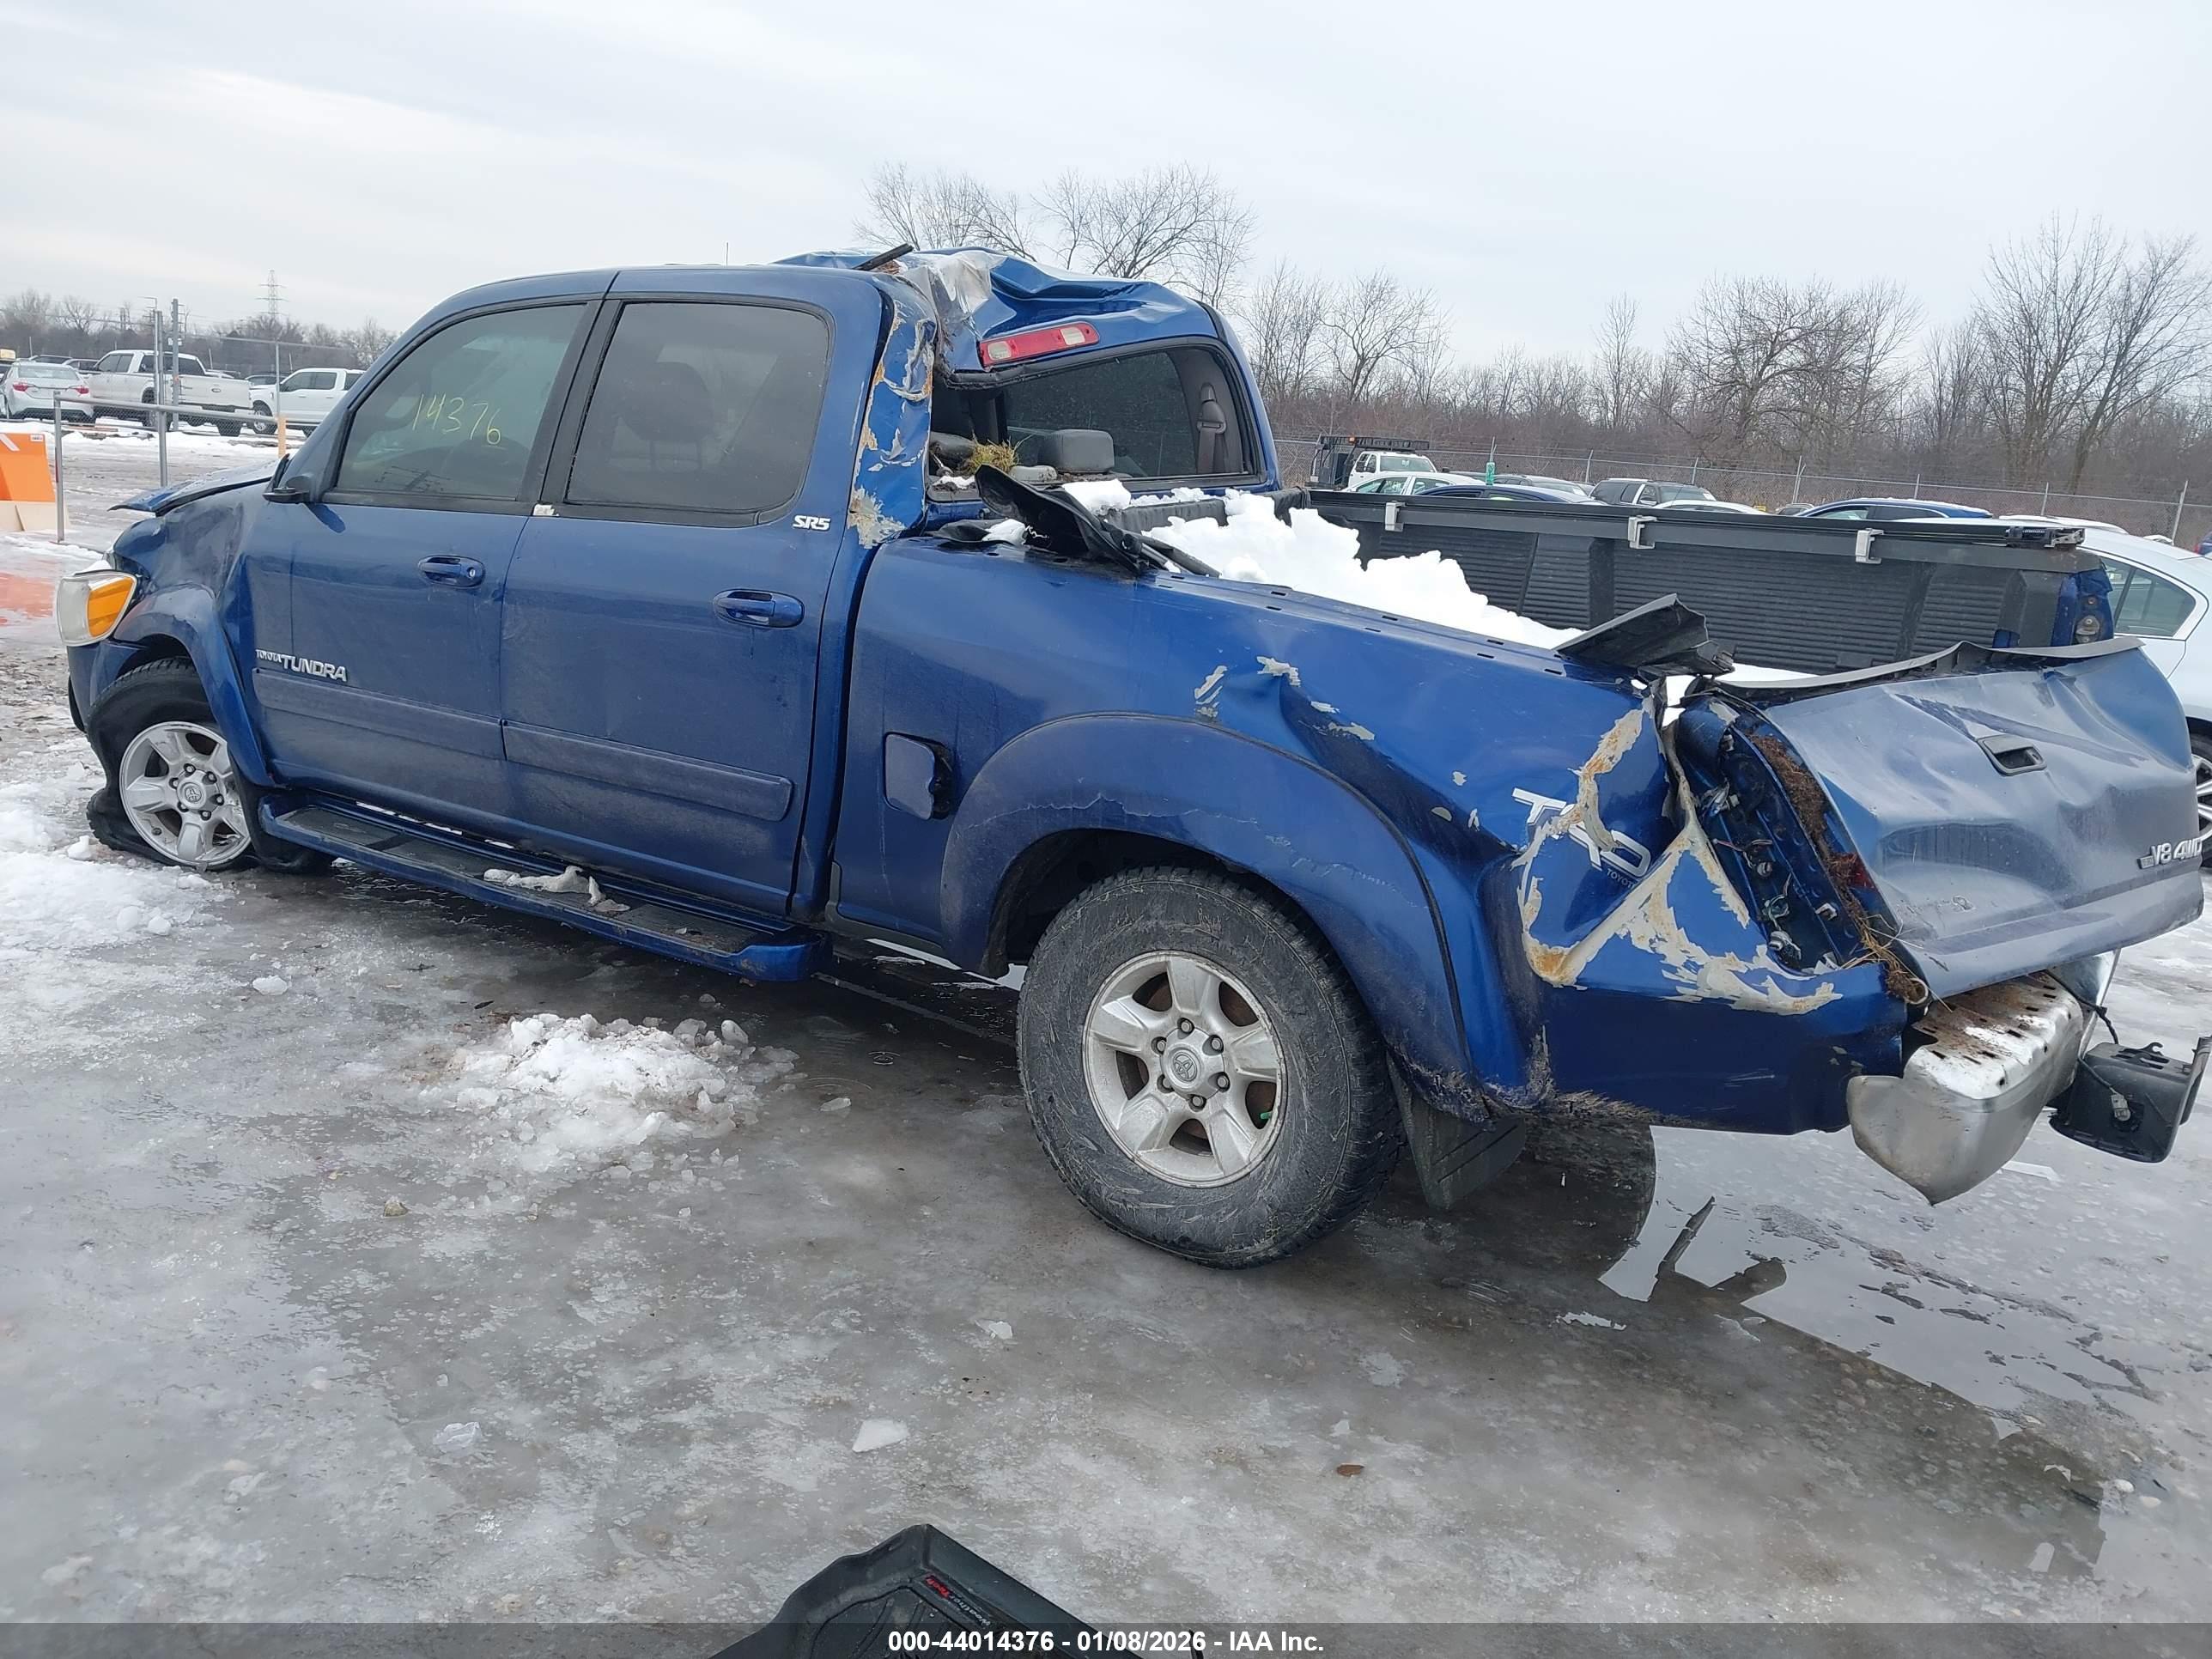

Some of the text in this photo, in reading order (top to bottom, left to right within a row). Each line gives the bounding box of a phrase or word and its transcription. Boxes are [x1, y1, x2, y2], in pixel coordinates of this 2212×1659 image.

[412, 392, 501, 445] 14376
[793, 514, 831, 531] SR5
[255, 648, 348, 683] TOYOTA TUNDRA
[2150, 842, 2172, 866] V8
[2172, 839, 2203, 860] 4WD
